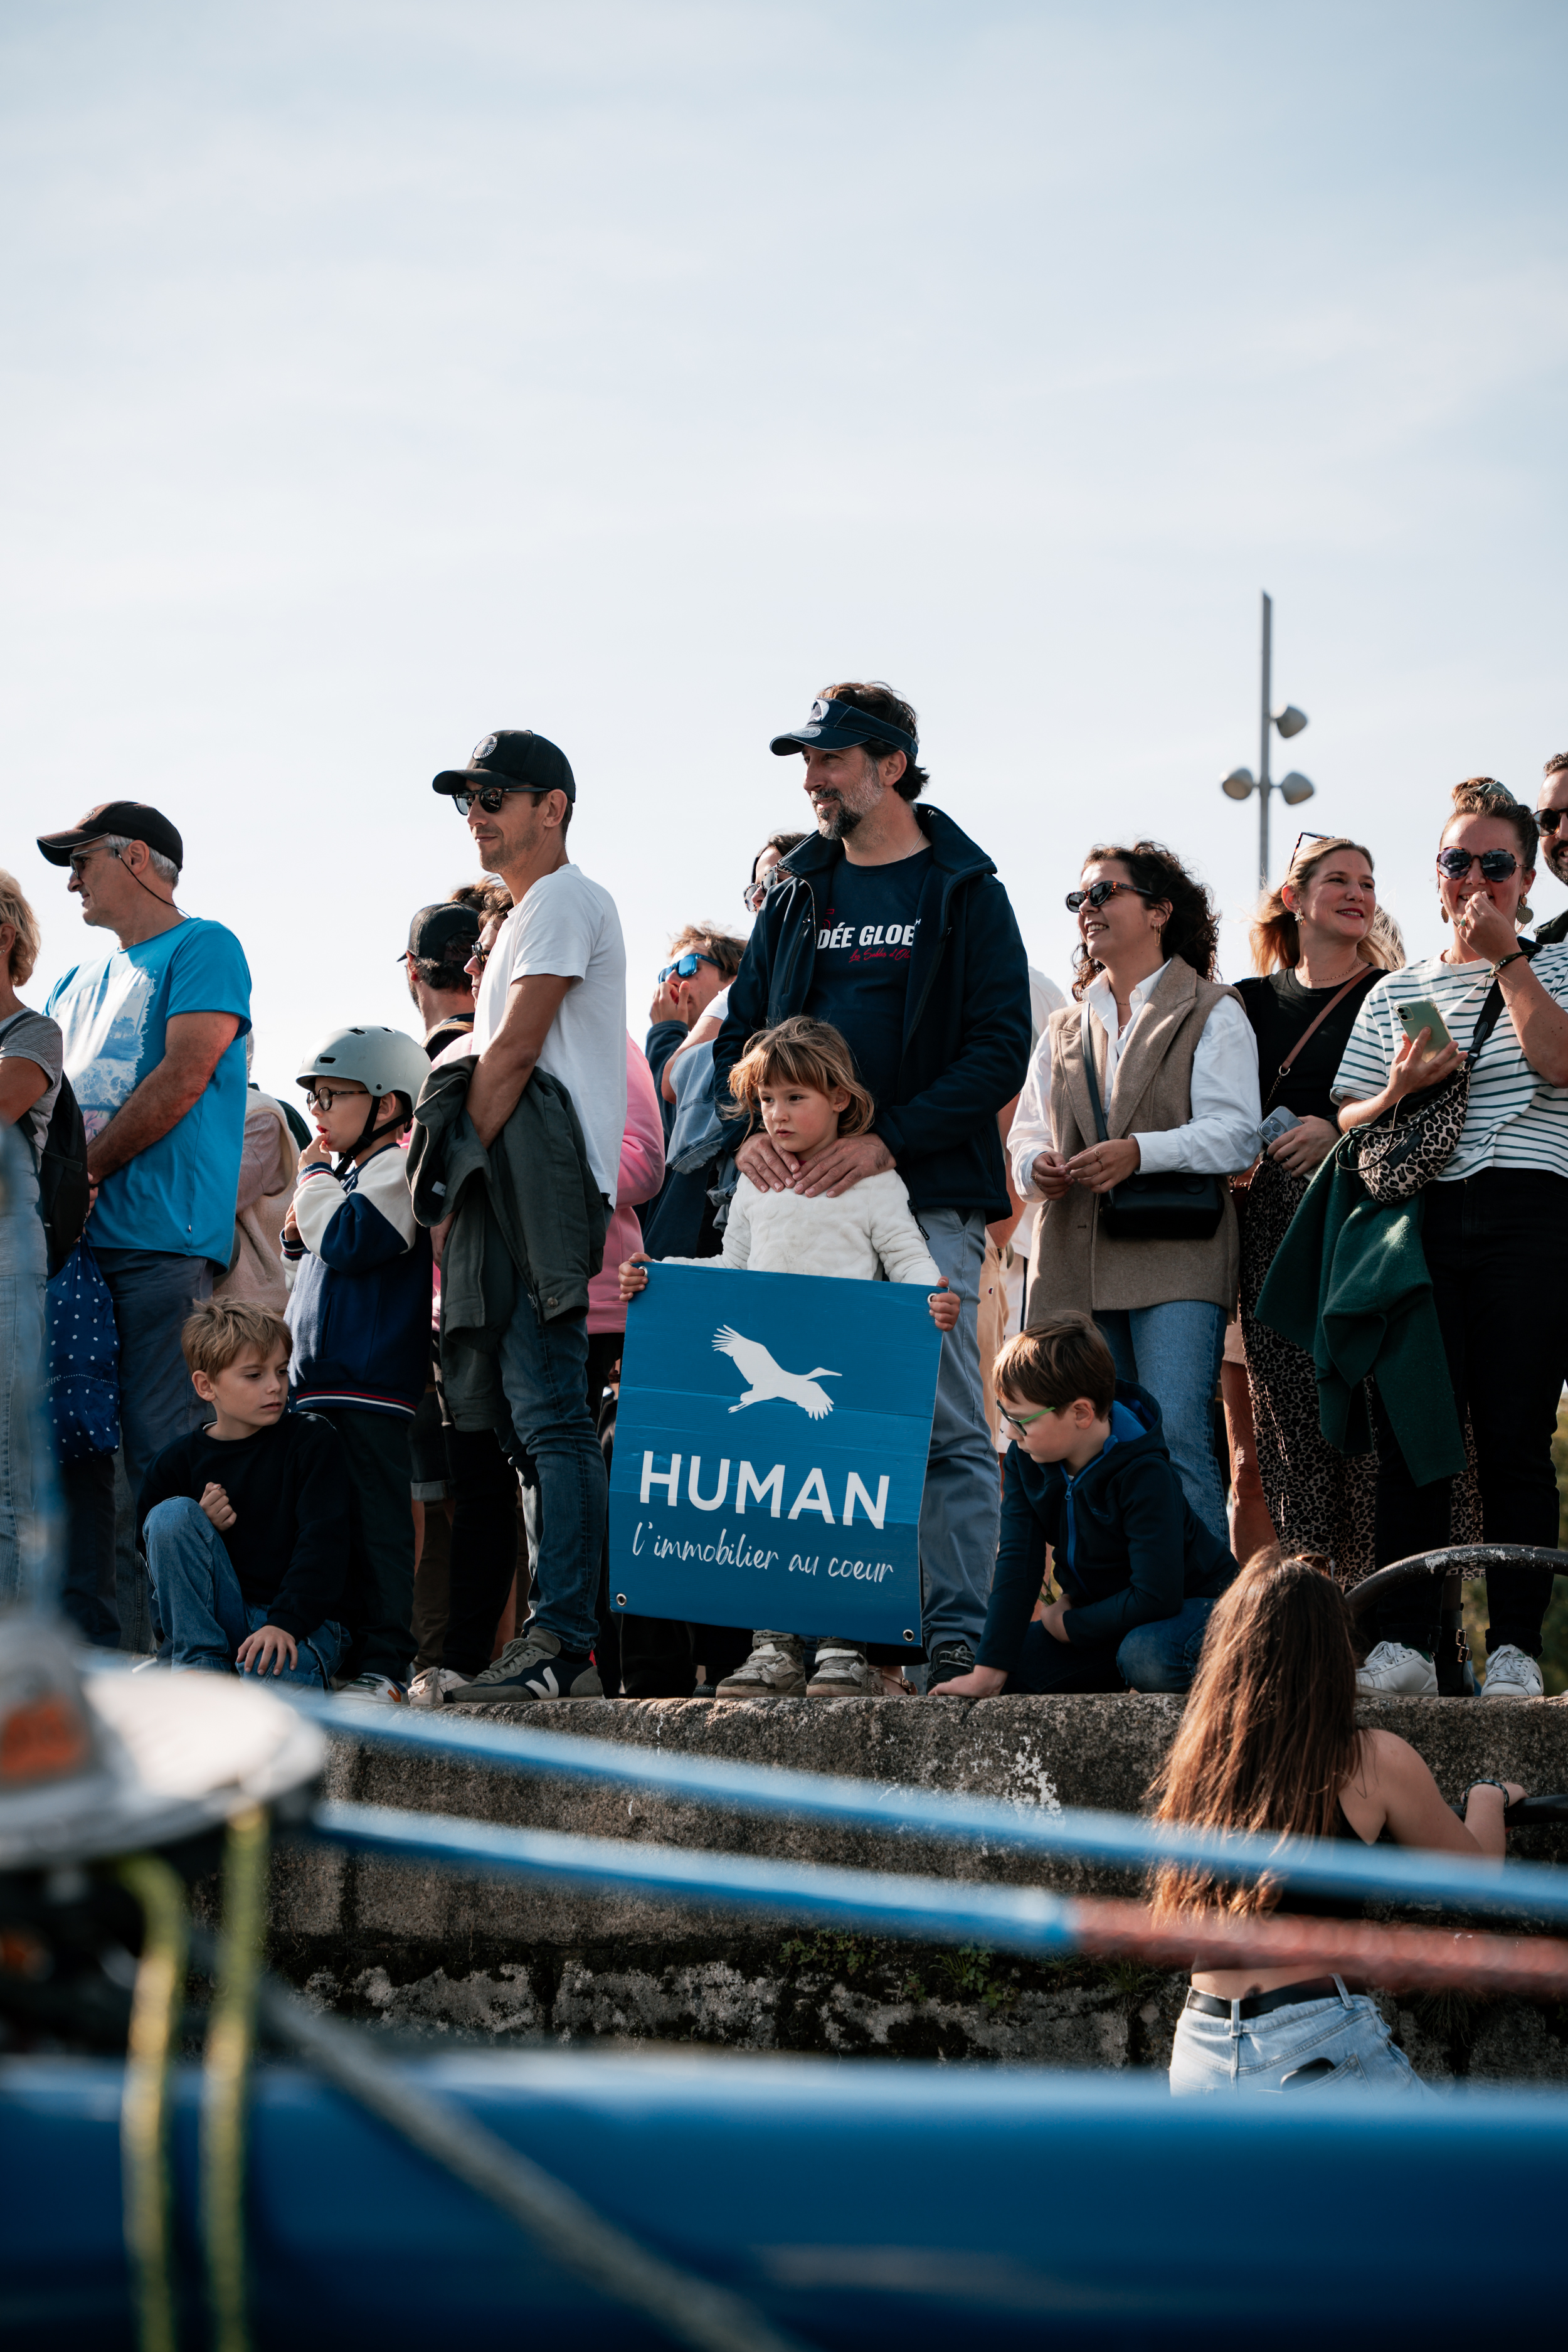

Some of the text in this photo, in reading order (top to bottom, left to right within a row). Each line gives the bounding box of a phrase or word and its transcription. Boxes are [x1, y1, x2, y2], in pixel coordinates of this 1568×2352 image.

[817, 921, 856, 949] DÉE
[849, 948, 862, 963] Les
[640, 1450, 890, 1530] HUMAN
[632, 1522, 894, 1582] l'immobilier au coeur
